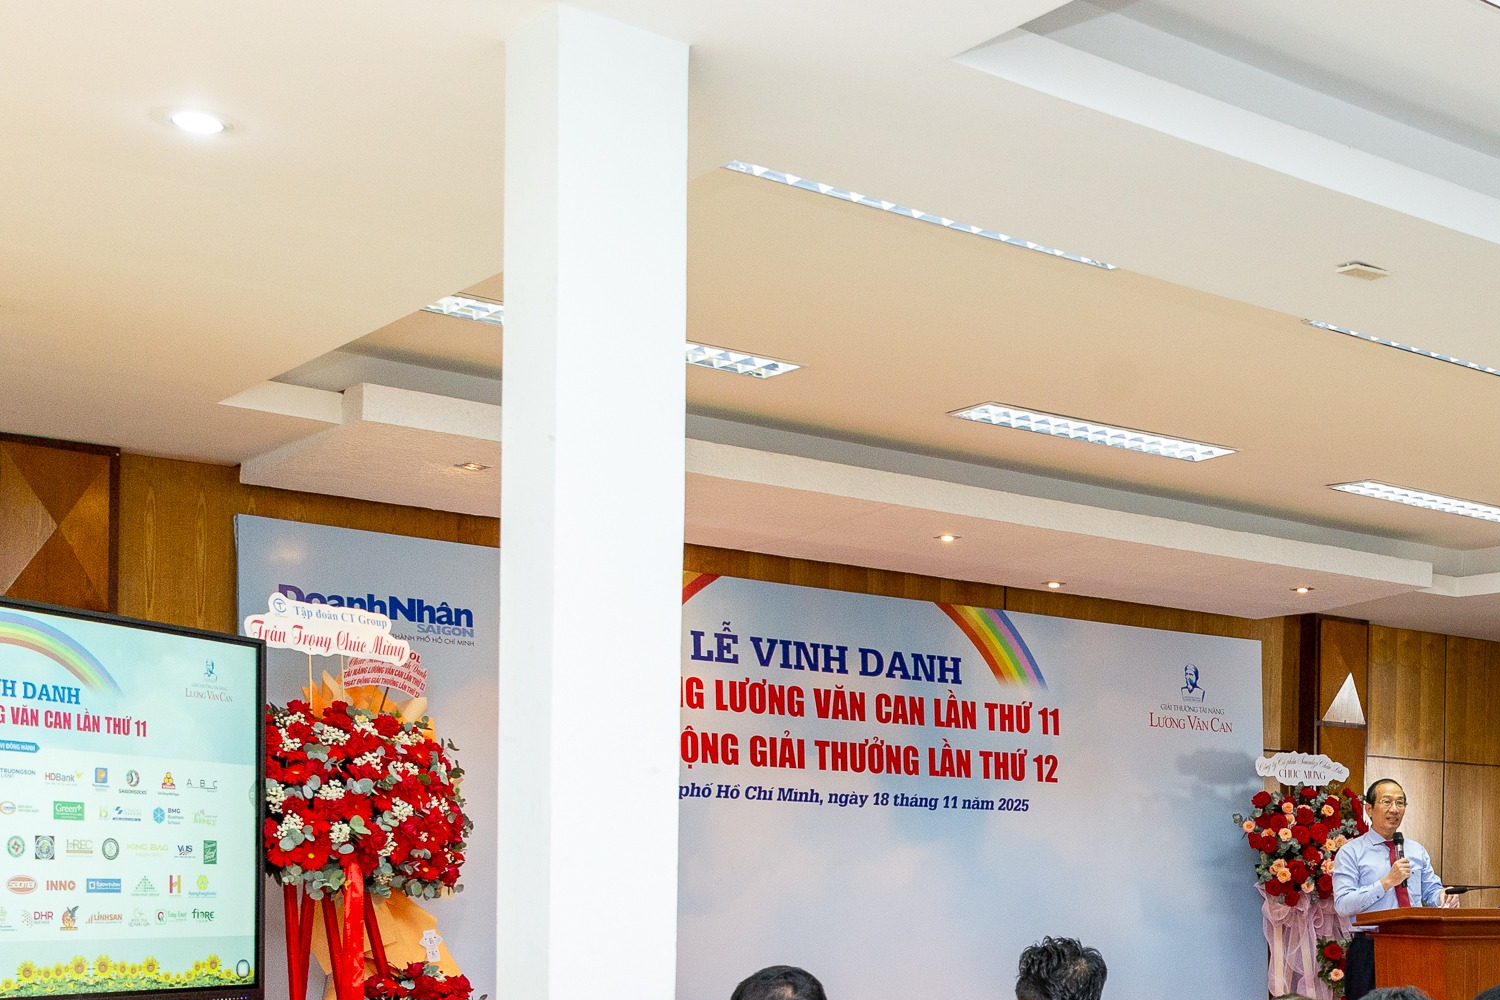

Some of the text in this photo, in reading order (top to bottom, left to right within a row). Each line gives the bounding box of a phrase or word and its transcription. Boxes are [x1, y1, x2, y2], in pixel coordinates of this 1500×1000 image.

[293, 606, 387, 629] Tập đoàn CT Group
[292, 624, 332, 653] Trọng
[336, 631, 366, 652] Chúc
[690, 621, 962, 685] LỄ VINH DANH
[22, 681, 81, 705] DANH
[715, 677, 805, 718] LƯƠNG
[813, 684, 866, 722] VĂN
[875, 693, 925, 726] CAN
[934, 689, 977, 730] LẦN
[984, 701, 1033, 734] THỨ
[1038, 707, 1060, 736] 11
[10, 703, 39, 727] VĂN
[44, 709, 72, 730] CAN
[76, 708, 101, 733] LẦN
[105, 715, 132, 736] THỨ
[135, 720, 147, 737] 11
[681, 725, 1059, 783] ỘNG GIẢI THƯỞNG LẦN THỨ 12
[45, 772, 75, 782] HDBank
[679, 782, 1030, 812] phố Hồ Chí Minh, ngày 18 tháng 11 năm 2025
[46, 880, 76, 891] INNO
[33, 911, 53, 920] DHR
